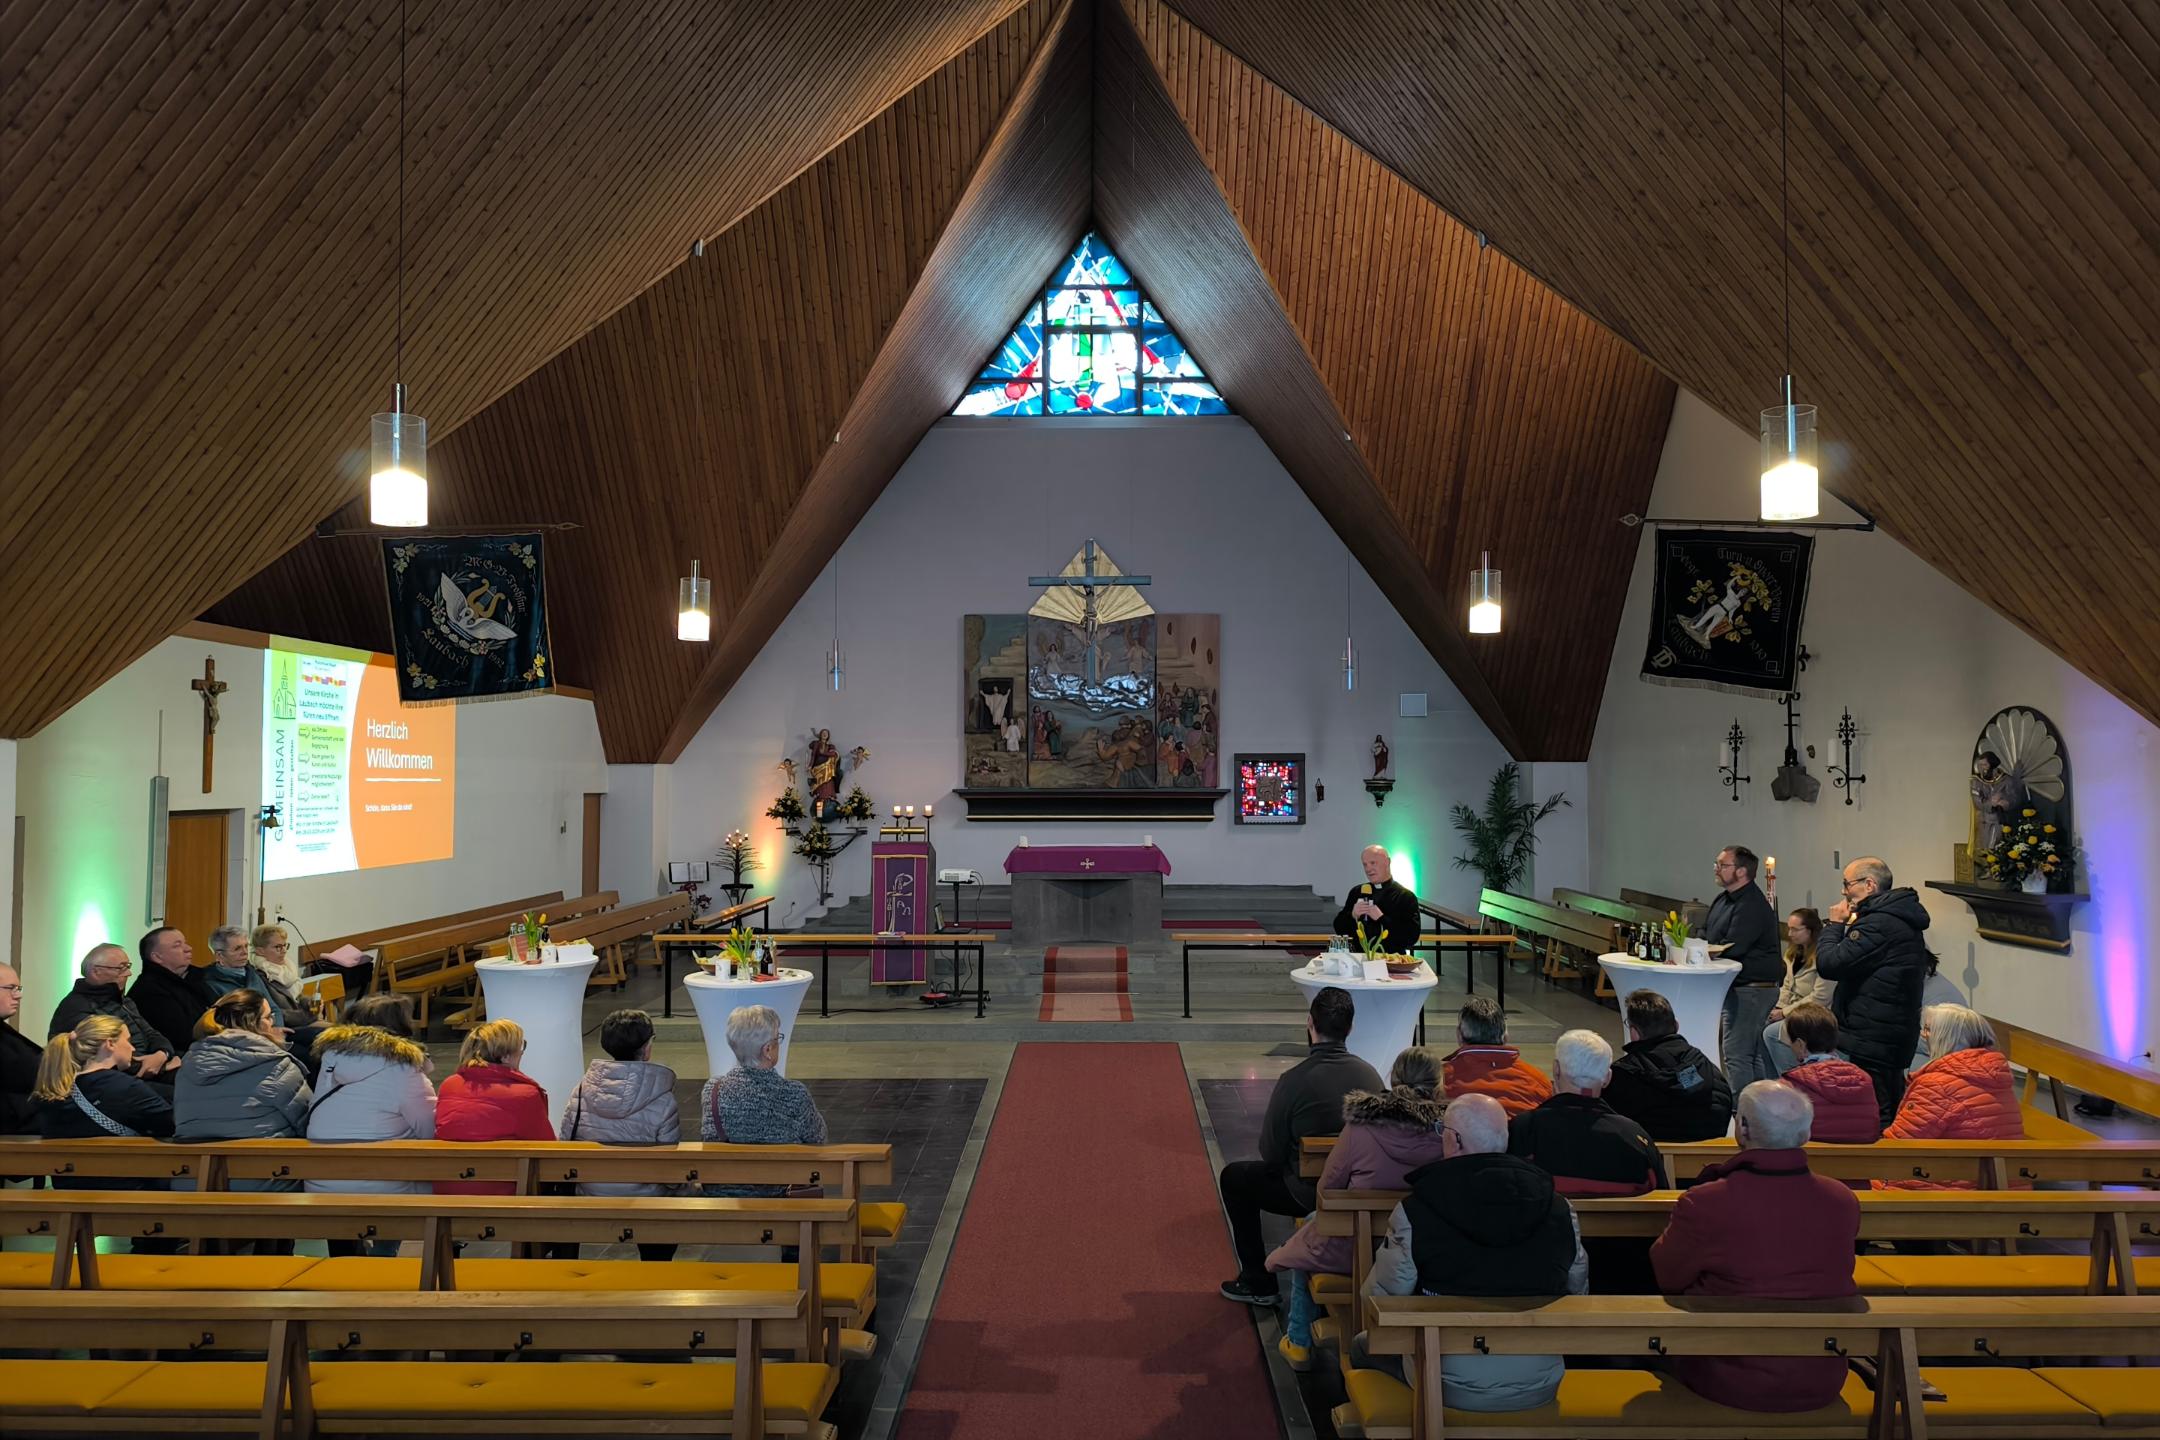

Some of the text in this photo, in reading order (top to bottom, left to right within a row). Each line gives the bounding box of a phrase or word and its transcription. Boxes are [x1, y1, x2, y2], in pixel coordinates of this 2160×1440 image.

[420, 628, 470, 667] Laubach
[366, 718, 408, 740] Herzlich
[365, 747, 433, 770] Willkommen
[275, 729, 285, 842] GEMEINSAM
